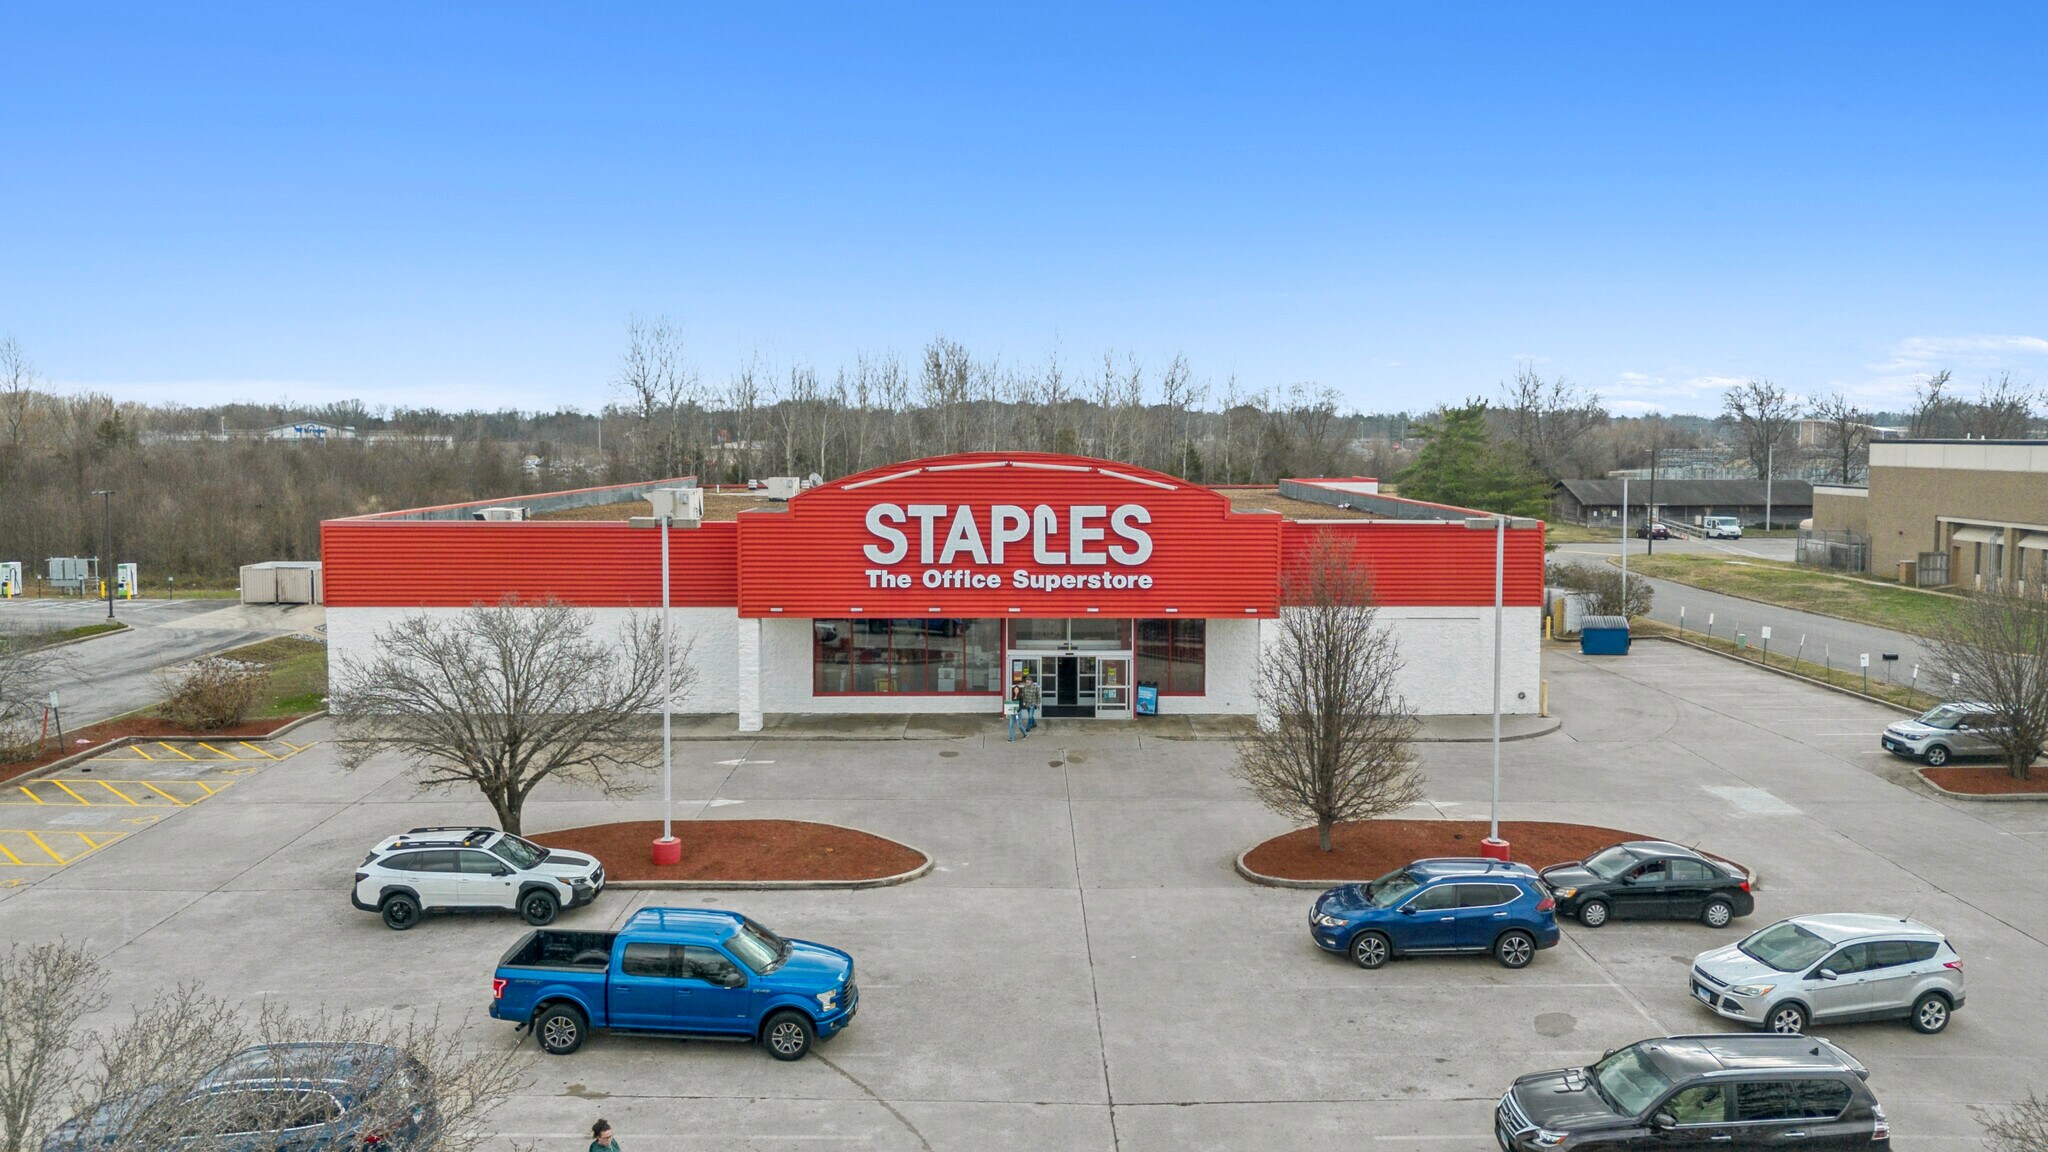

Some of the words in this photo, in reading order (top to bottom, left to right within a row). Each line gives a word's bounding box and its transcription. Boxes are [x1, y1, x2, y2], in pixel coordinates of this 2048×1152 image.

[863, 503, 1153, 565] STAPLES
[865, 569, 911, 588] The
[923, 569, 1001, 588] Office
[1013, 569, 1153, 591] Superstore
